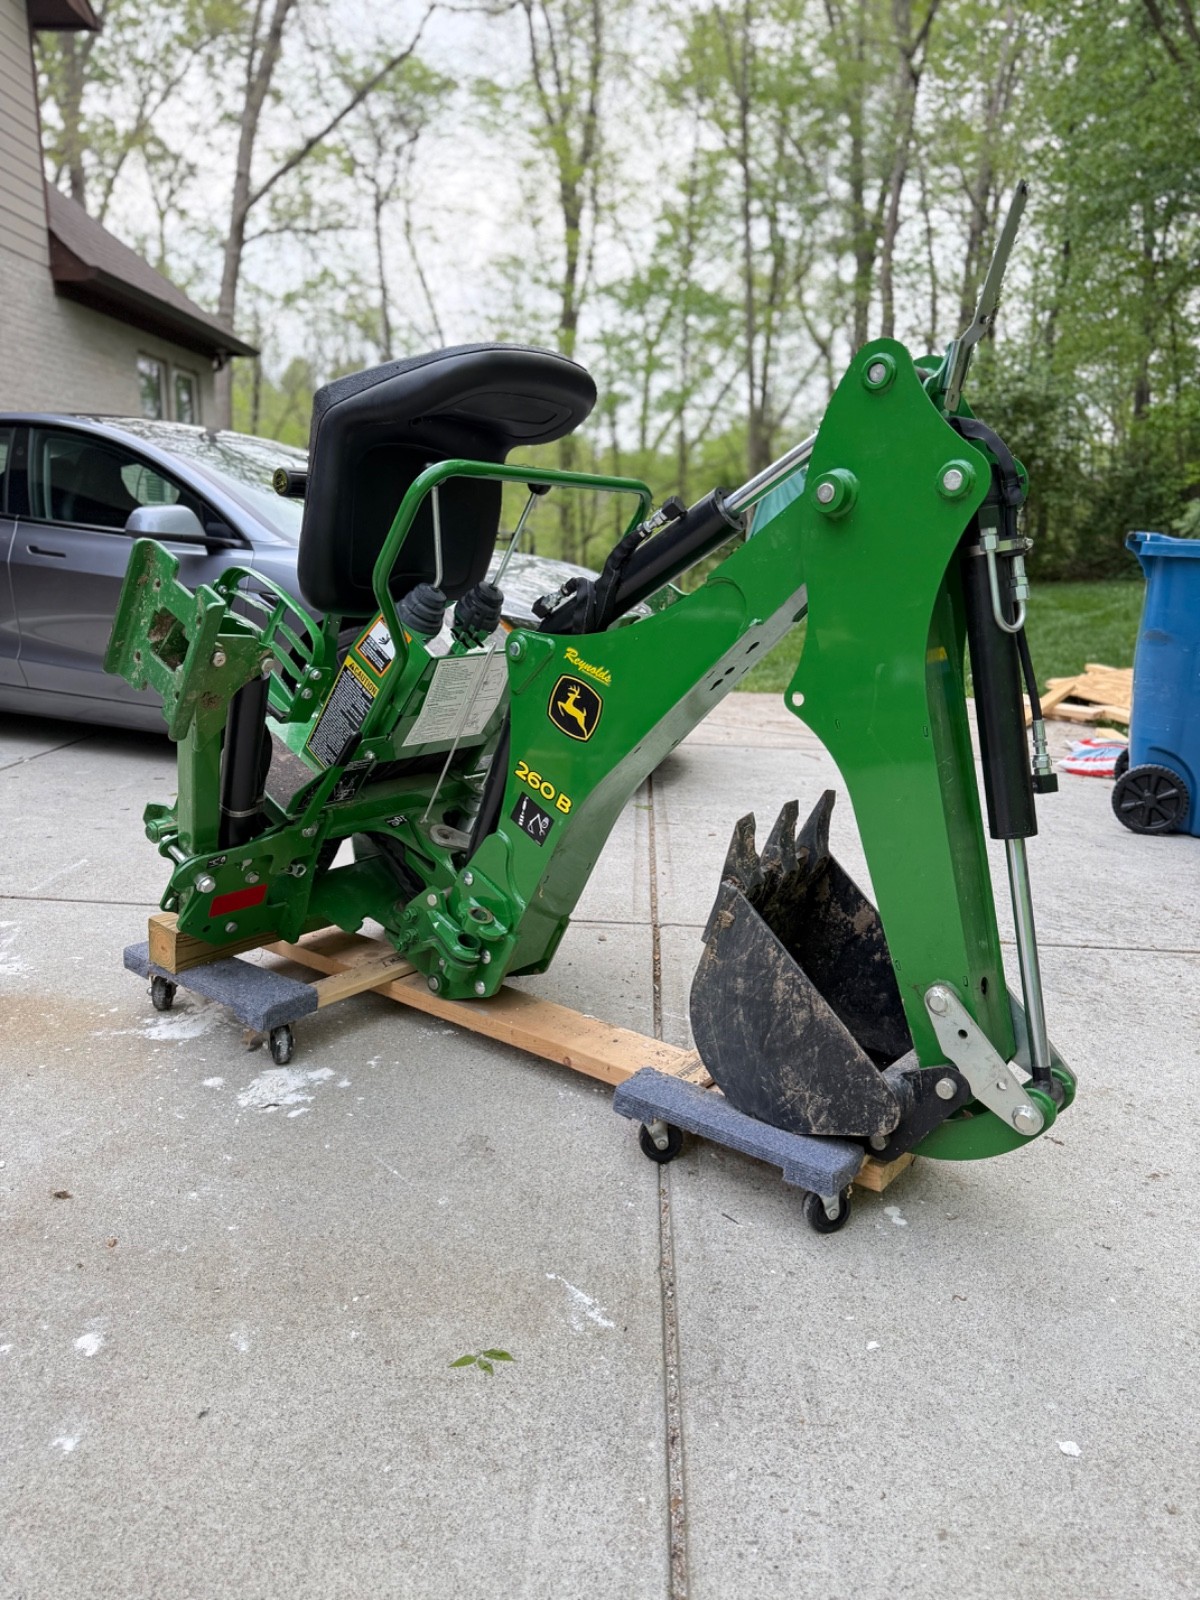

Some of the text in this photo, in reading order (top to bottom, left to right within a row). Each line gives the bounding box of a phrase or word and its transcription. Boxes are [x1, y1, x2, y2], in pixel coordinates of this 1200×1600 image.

[353, 665, 378, 696] CAUTION
[563, 647, 612, 685] Reynolds
[514, 760, 572, 814] 260 B
